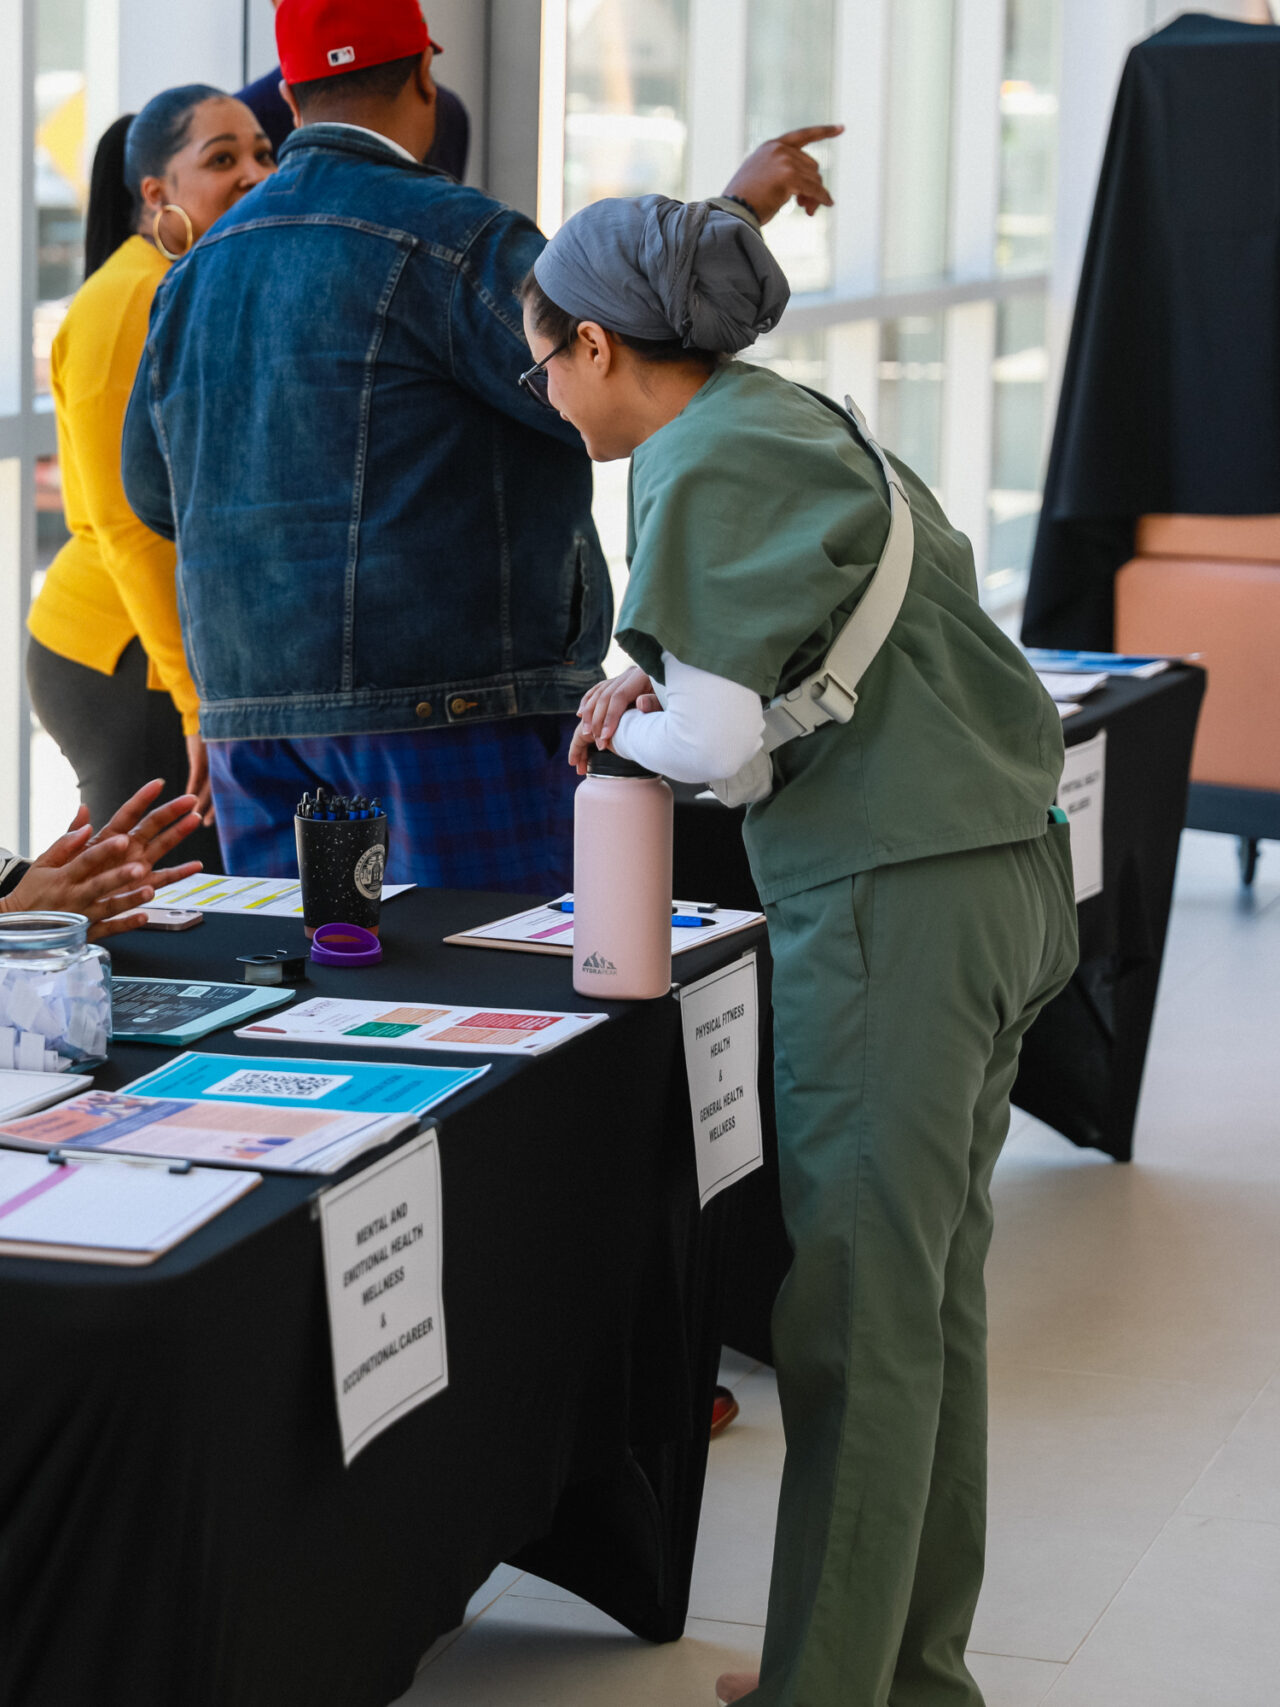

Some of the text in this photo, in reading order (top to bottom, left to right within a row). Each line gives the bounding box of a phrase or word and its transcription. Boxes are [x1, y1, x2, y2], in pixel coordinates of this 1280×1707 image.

[695, 1003, 745, 1041] PHYSICAL FITNESS
[710, 1036, 731, 1059] HEALTH
[700, 1085, 744, 1123] GENERAL HEALTH
[709, 1115, 736, 1144] WELLNESS
[356, 1201, 408, 1247] MENTAL AND
[343, 1222, 424, 1289] EMOTIONAL HEALTH
[362, 1265, 406, 1307] WELLNESS
